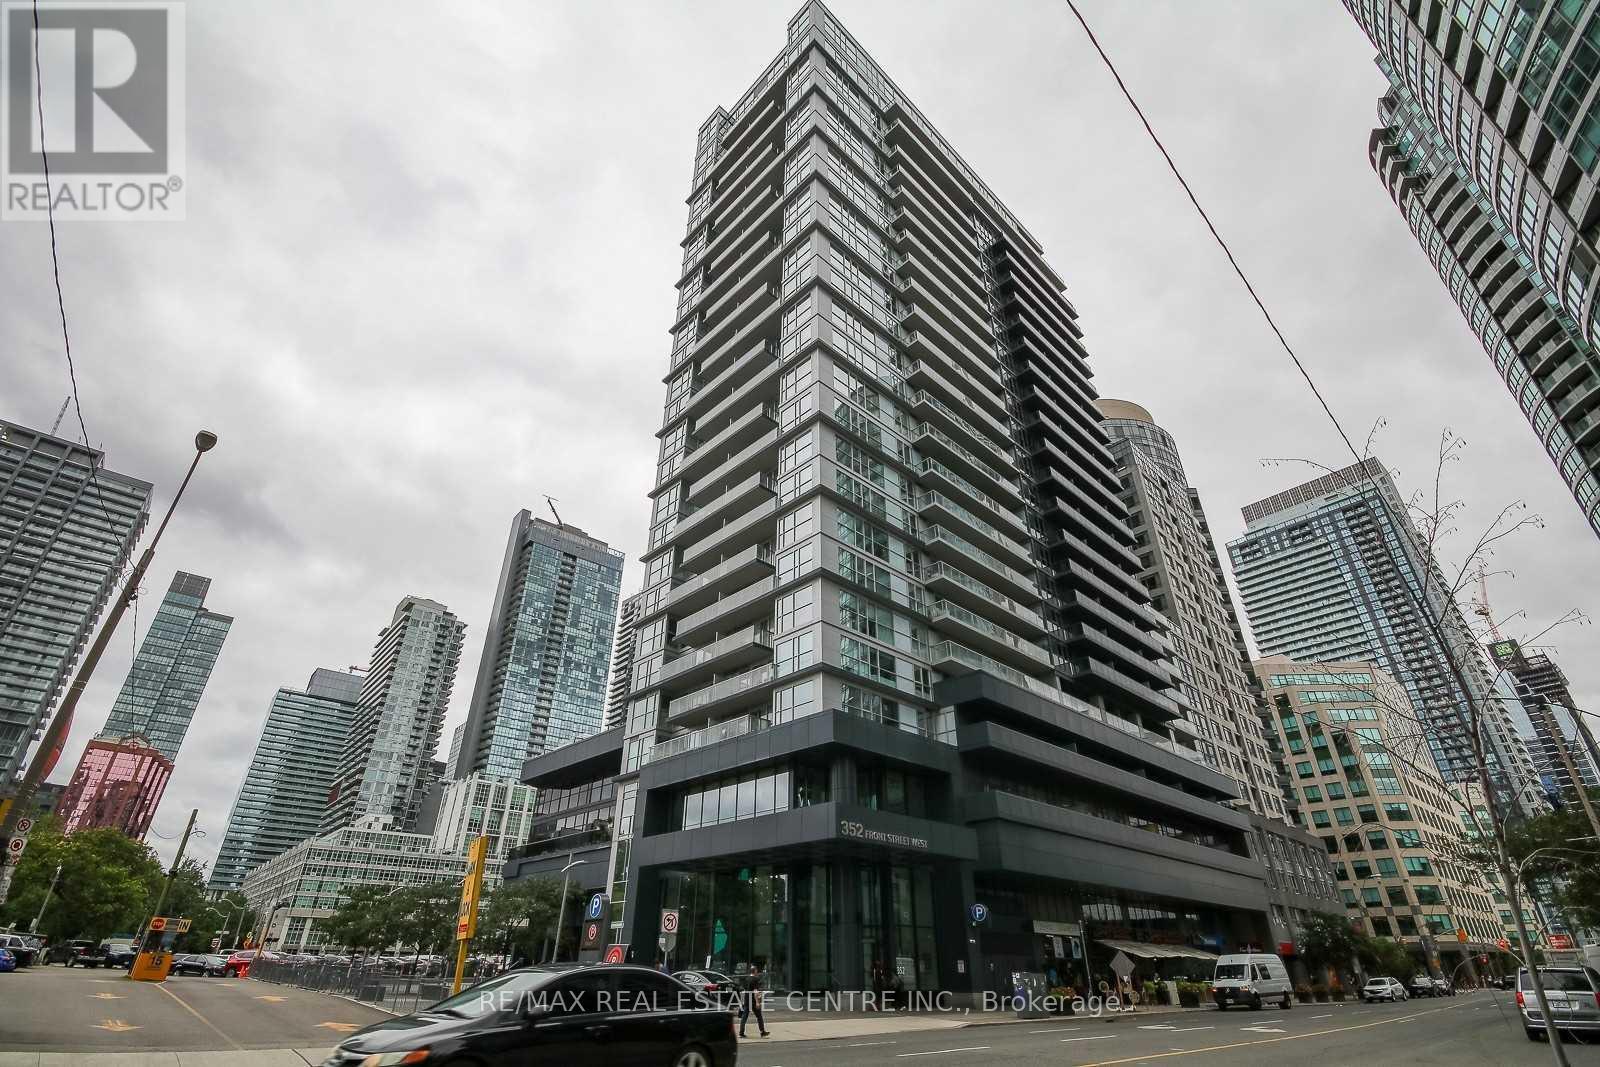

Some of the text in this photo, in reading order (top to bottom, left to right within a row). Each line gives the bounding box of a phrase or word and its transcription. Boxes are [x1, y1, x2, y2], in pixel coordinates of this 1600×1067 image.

[840, 820, 928, 849] 352 FRONT STREET WEST
